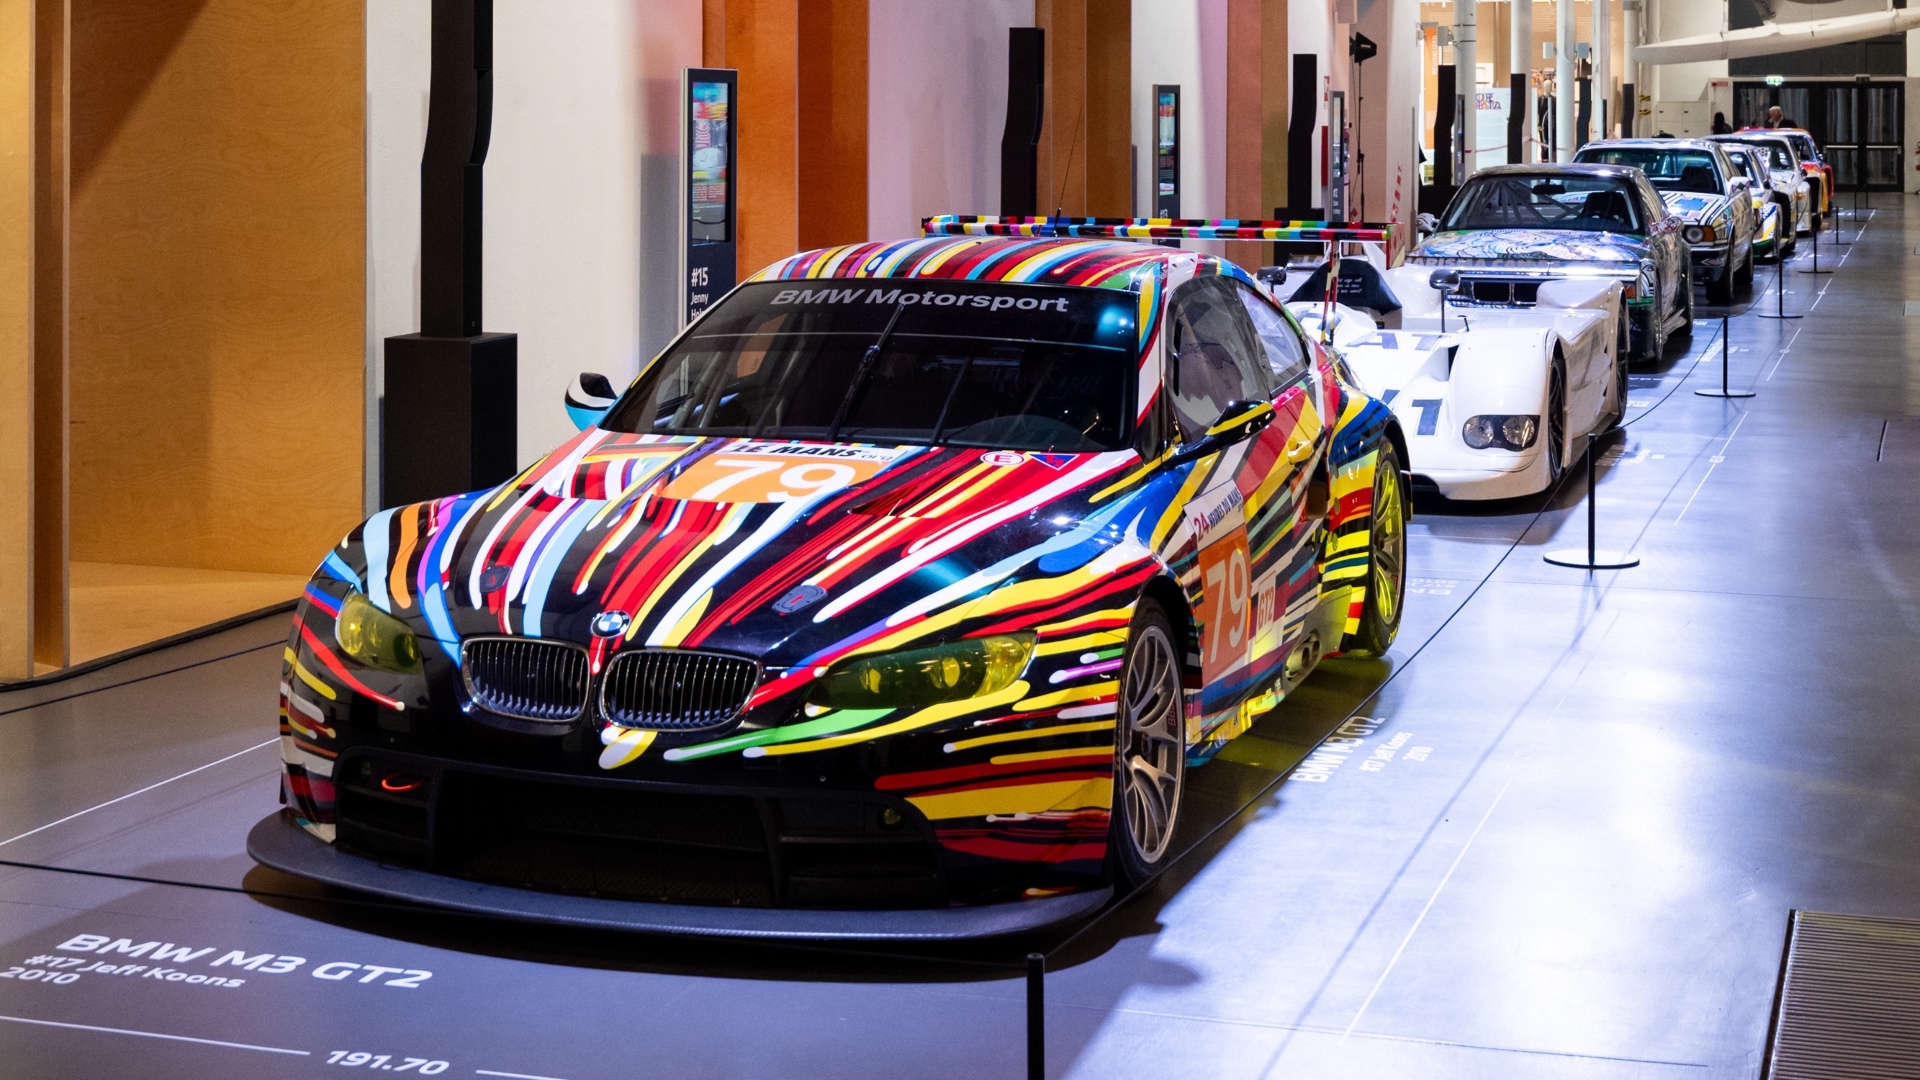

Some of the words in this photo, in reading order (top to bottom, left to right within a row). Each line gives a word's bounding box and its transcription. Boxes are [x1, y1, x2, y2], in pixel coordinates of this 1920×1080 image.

[691, 267, 709, 287] #15
[691, 291, 709, 306] Jenny
[770, 289, 865, 305] BMW
[865, 288, 1070, 312] Motorsport
[769, 446, 862, 457] MANS
[691, 458, 856, 502] 79
[1194, 512, 1210, 542] 24
[1206, 548, 1248, 664] 79
[1258, 586, 1275, 629] GT2
[1288, 752, 1348, 783] BMW
[1338, 715, 1386, 736] GT2
[0, 966, 81, 985] 2010
[24, 954, 87, 968] #17
[75, 961, 149, 977] Jeff
[142, 967, 246, 988] Koons
[56, 933, 216, 963] BMW
[209, 950, 306, 974] M3
[312, 962, 433, 988] GT2
[326, 1050, 450, 1075] 191.70
